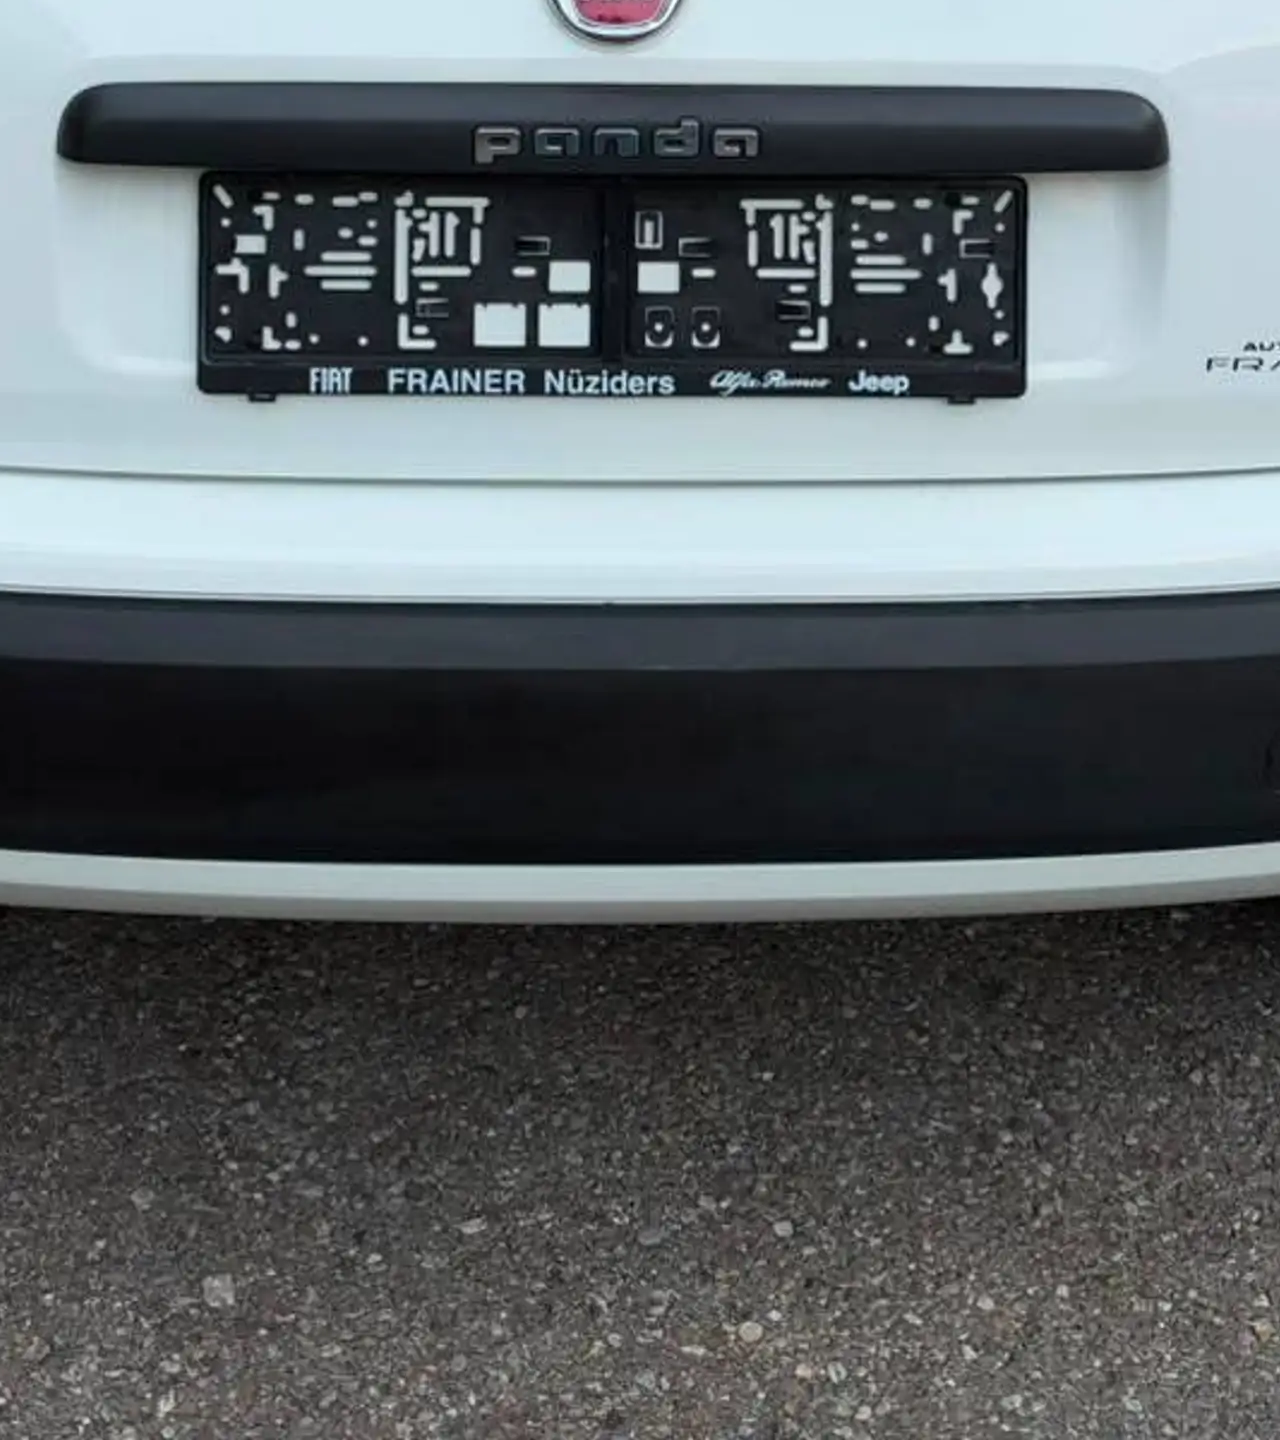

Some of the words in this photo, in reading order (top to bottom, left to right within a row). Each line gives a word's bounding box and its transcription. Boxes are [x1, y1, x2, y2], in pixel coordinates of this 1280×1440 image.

[475, 119, 759, 164] panda
[310, 366, 353, 393] FIAT
[388, 368, 526, 394] FRAINER
[544, 368, 676, 395] Nüziders
[848, 370, 911, 395] Jeep
